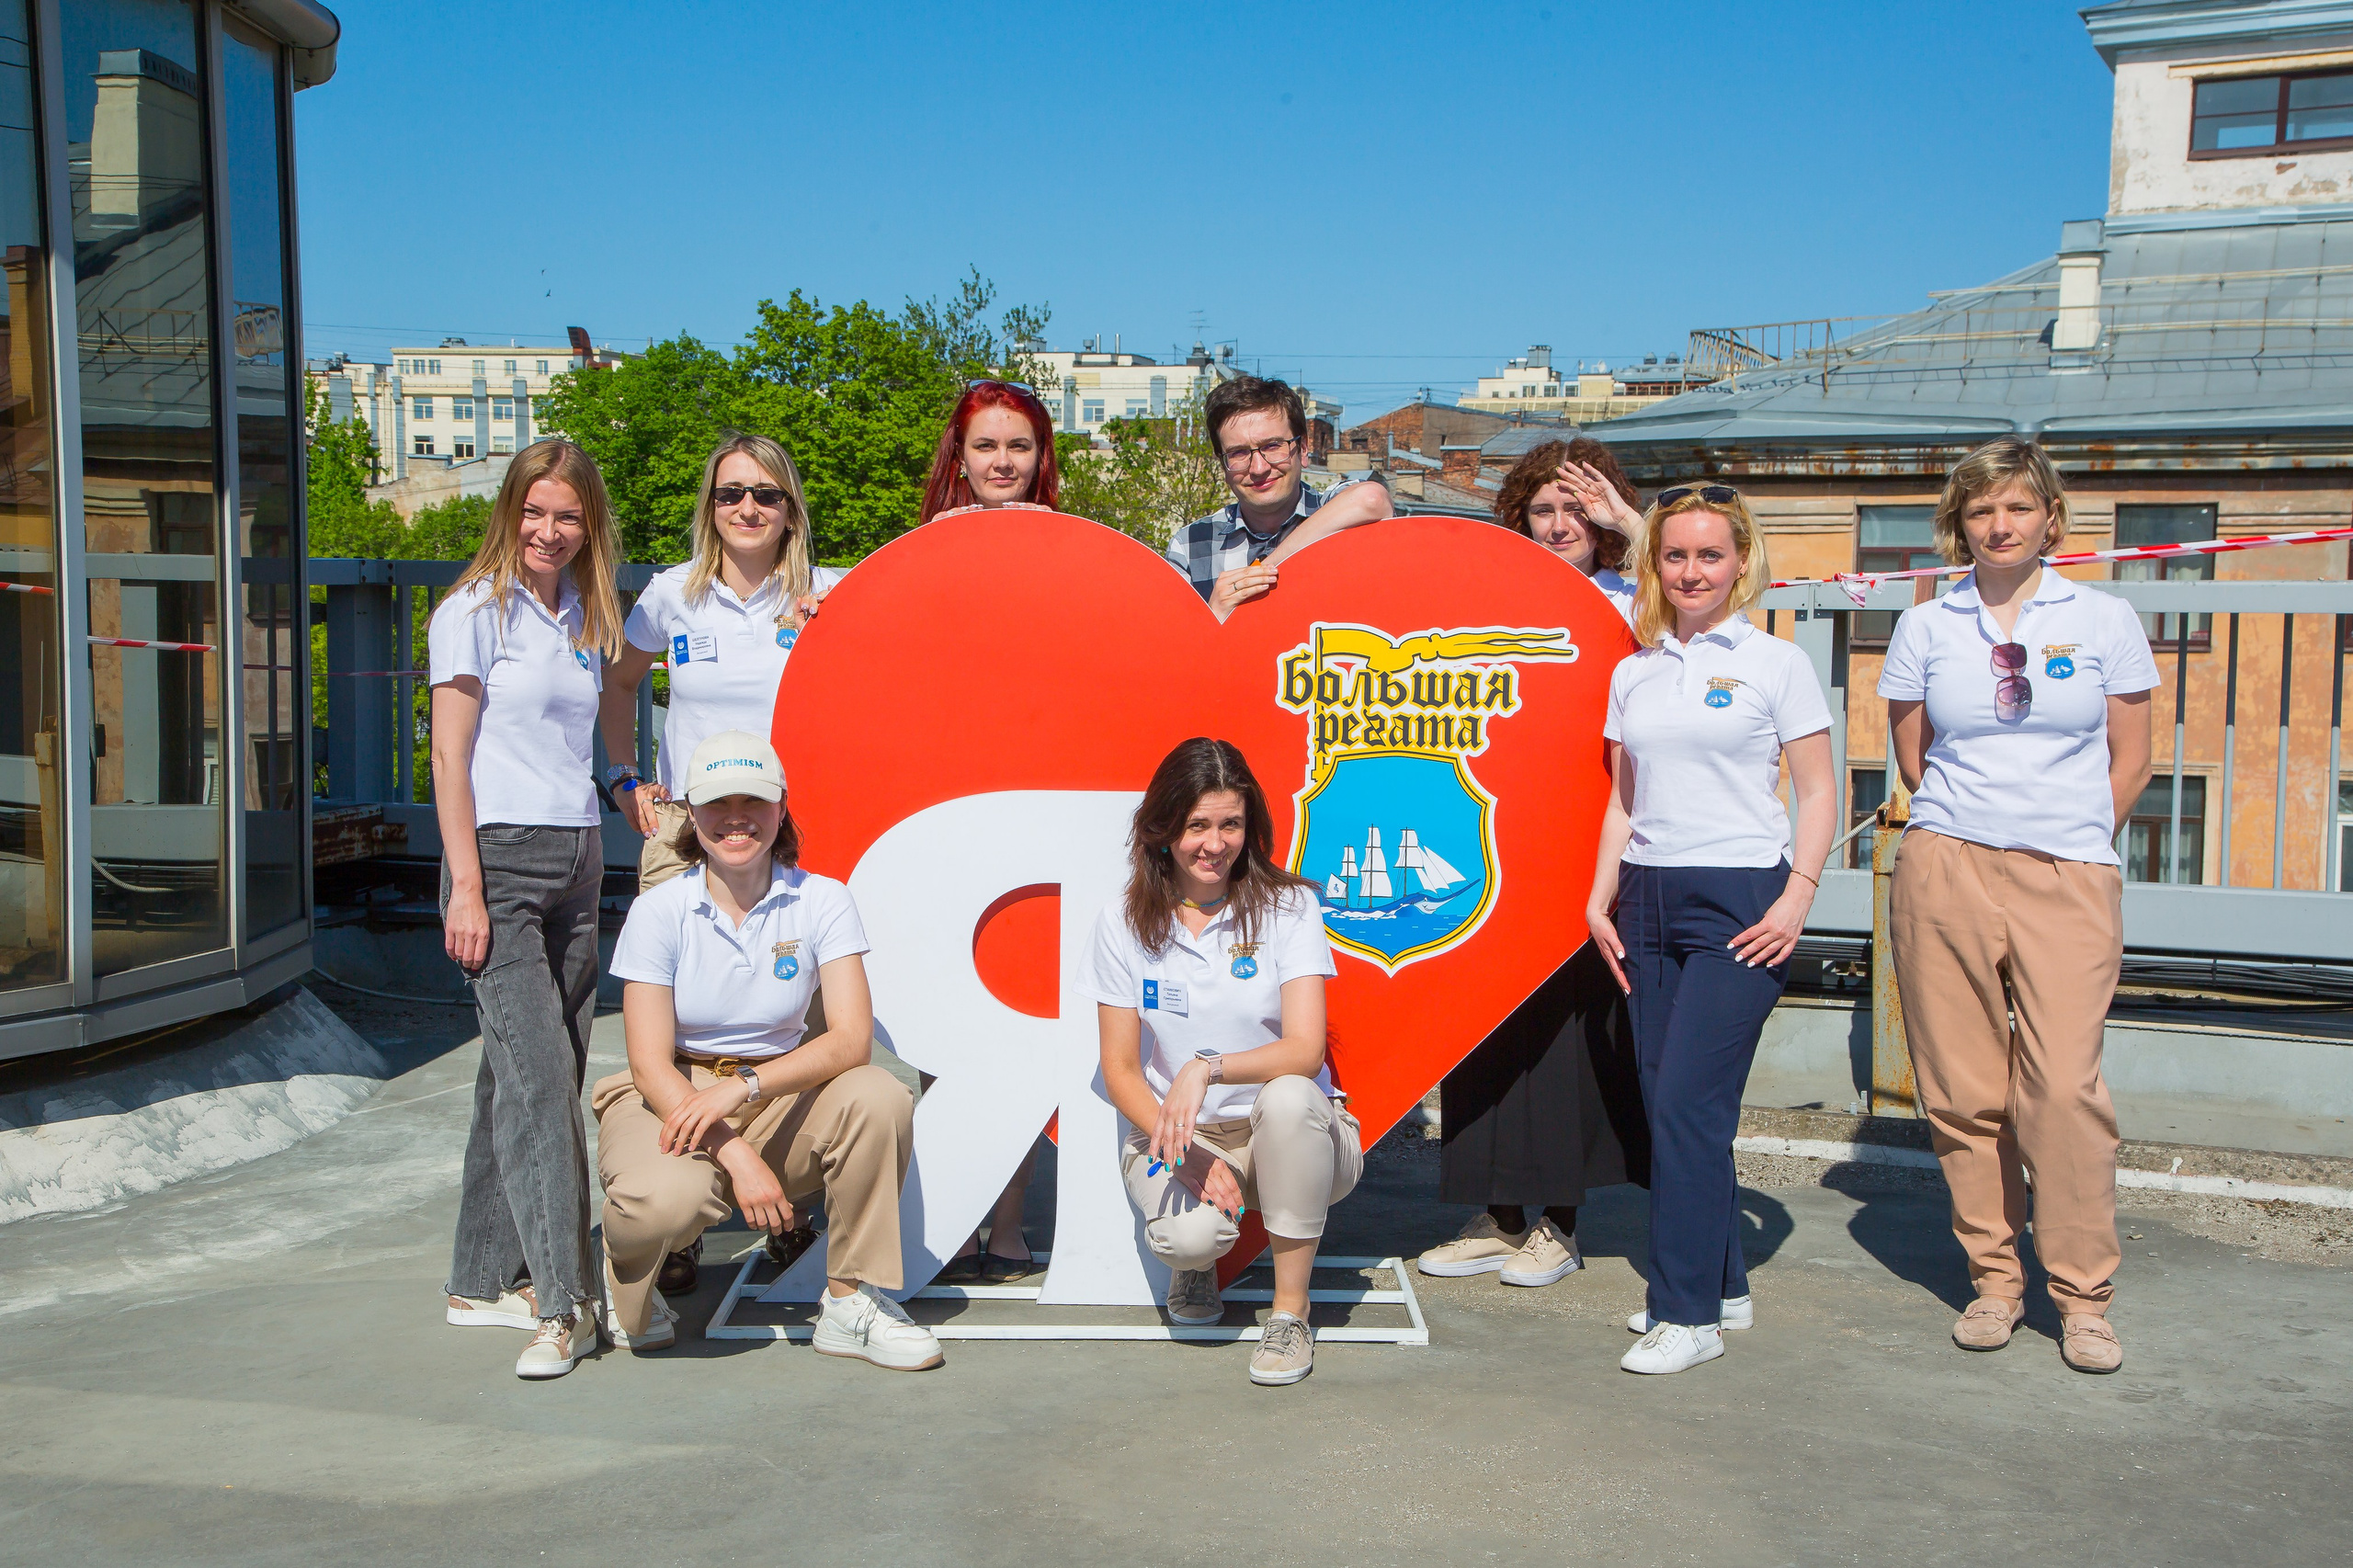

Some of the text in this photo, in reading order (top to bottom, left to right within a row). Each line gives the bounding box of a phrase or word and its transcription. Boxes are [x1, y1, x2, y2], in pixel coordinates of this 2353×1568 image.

[1314, 709, 1483, 754] регата
[706, 758, 764, 771] OPTIMISM
[756, 790, 1181, 1306] Я
